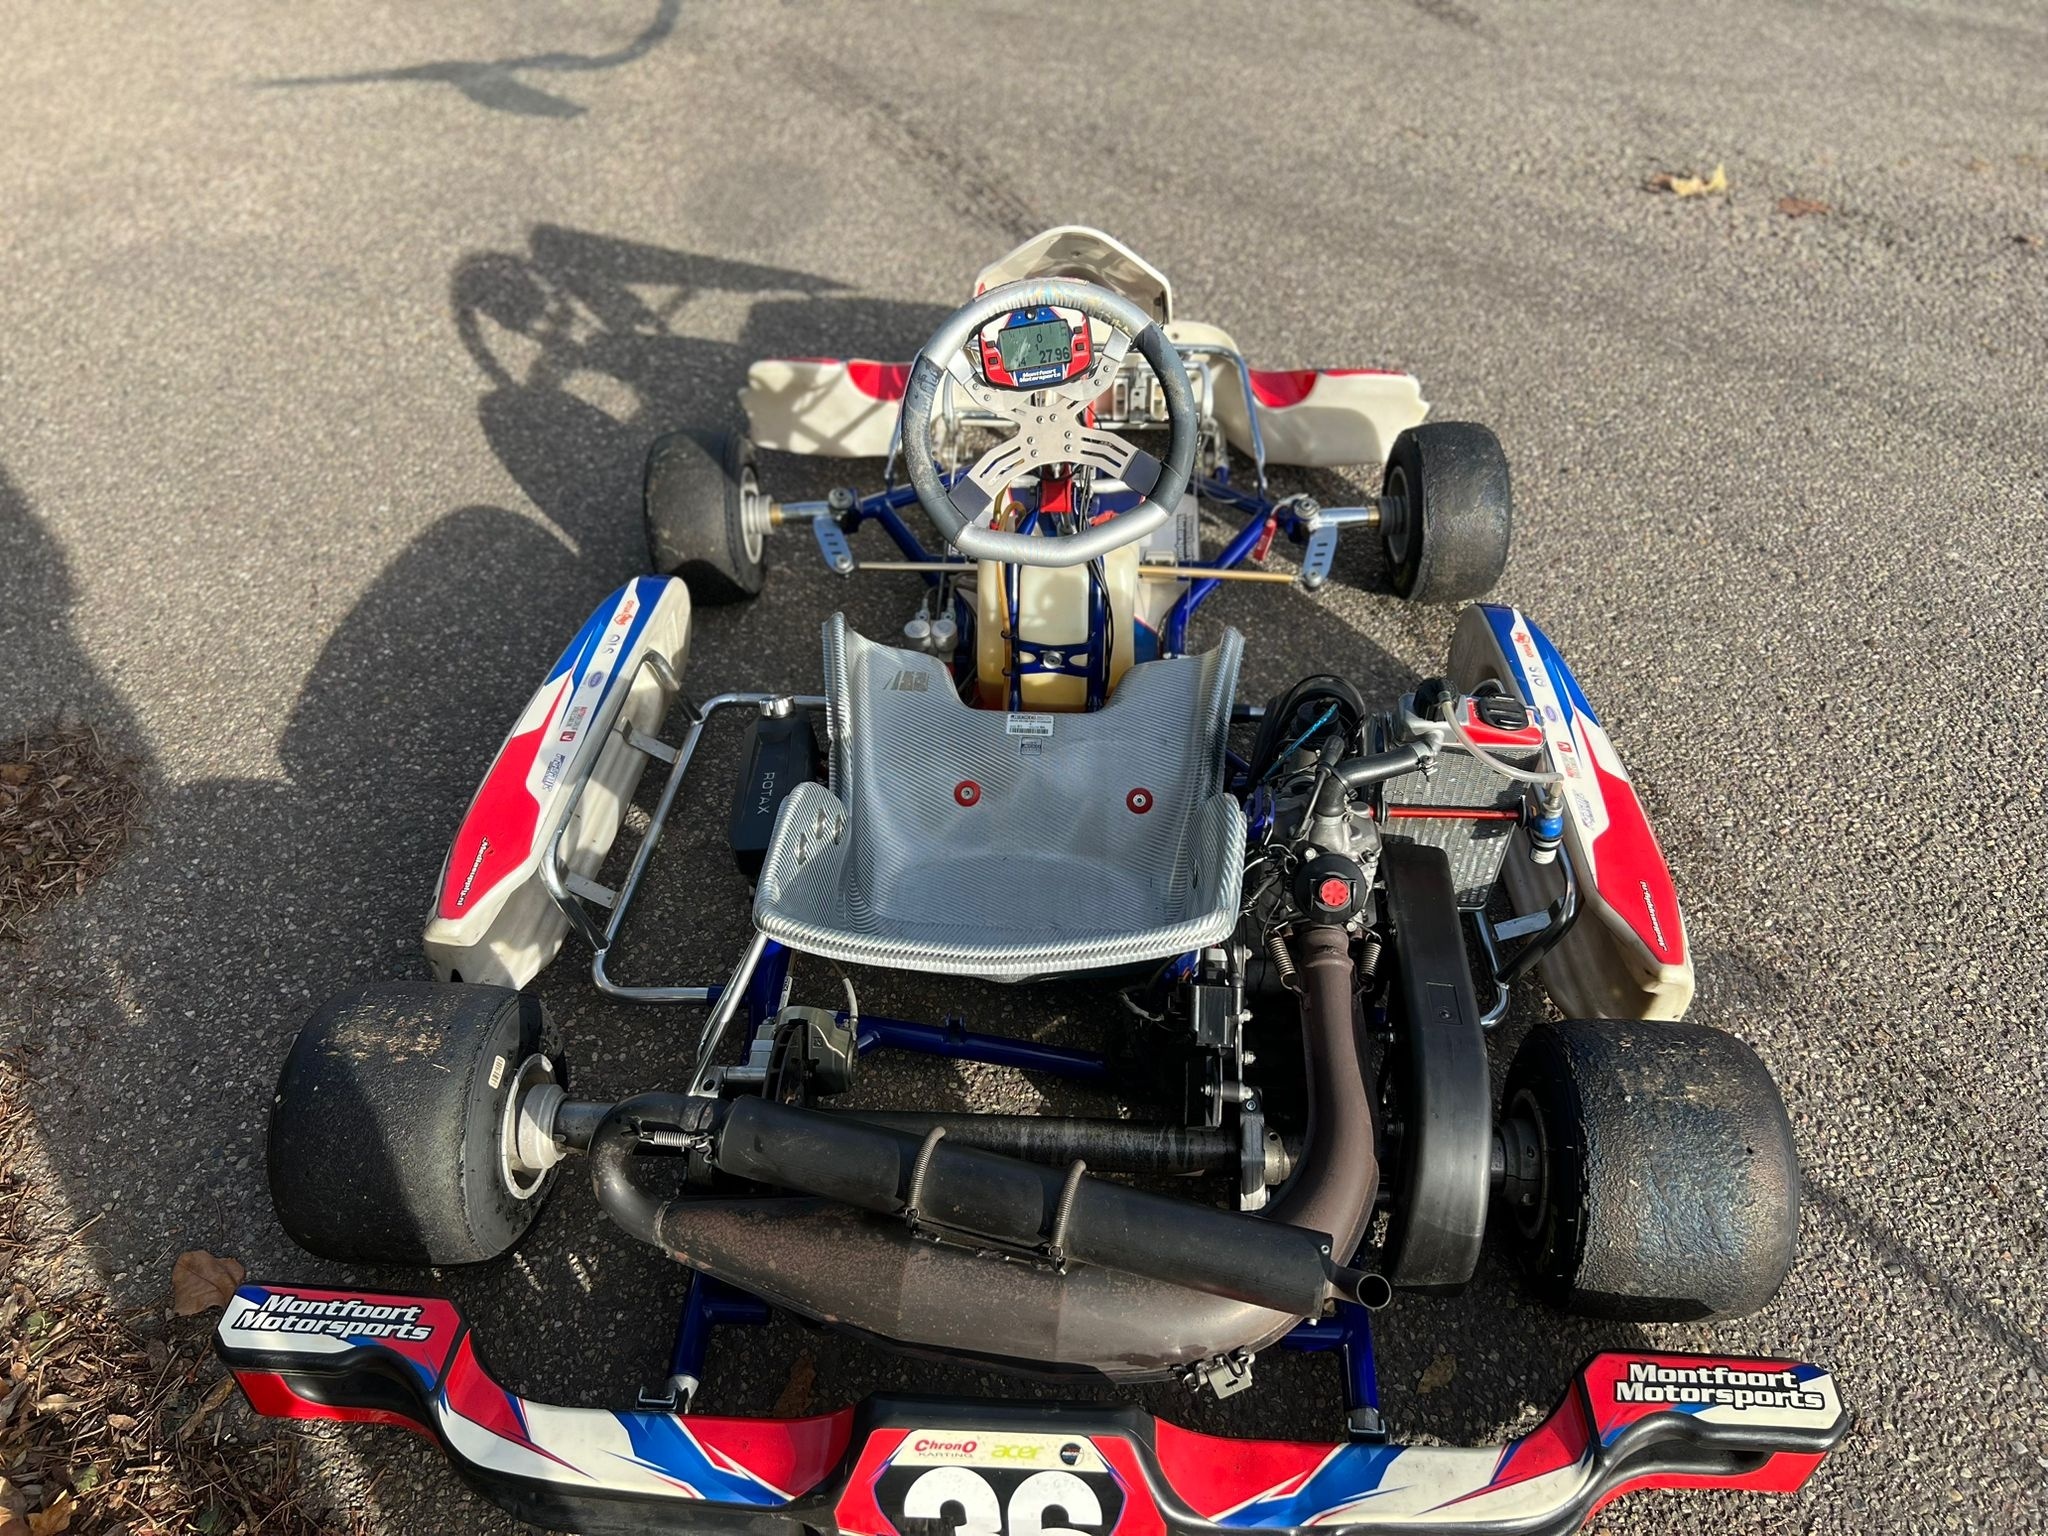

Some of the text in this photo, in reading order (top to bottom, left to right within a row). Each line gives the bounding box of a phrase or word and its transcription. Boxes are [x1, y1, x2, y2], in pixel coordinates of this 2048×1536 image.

[757, 772, 776, 815] ROTAX
[260, 1294, 422, 1322] Montfoort
[234, 1310, 433, 1340] Motorsports
[1629, 1363, 1798, 1388] Montfoort
[1616, 1382, 1824, 1409] Motorsports
[991, 1444, 1045, 1460] acer
